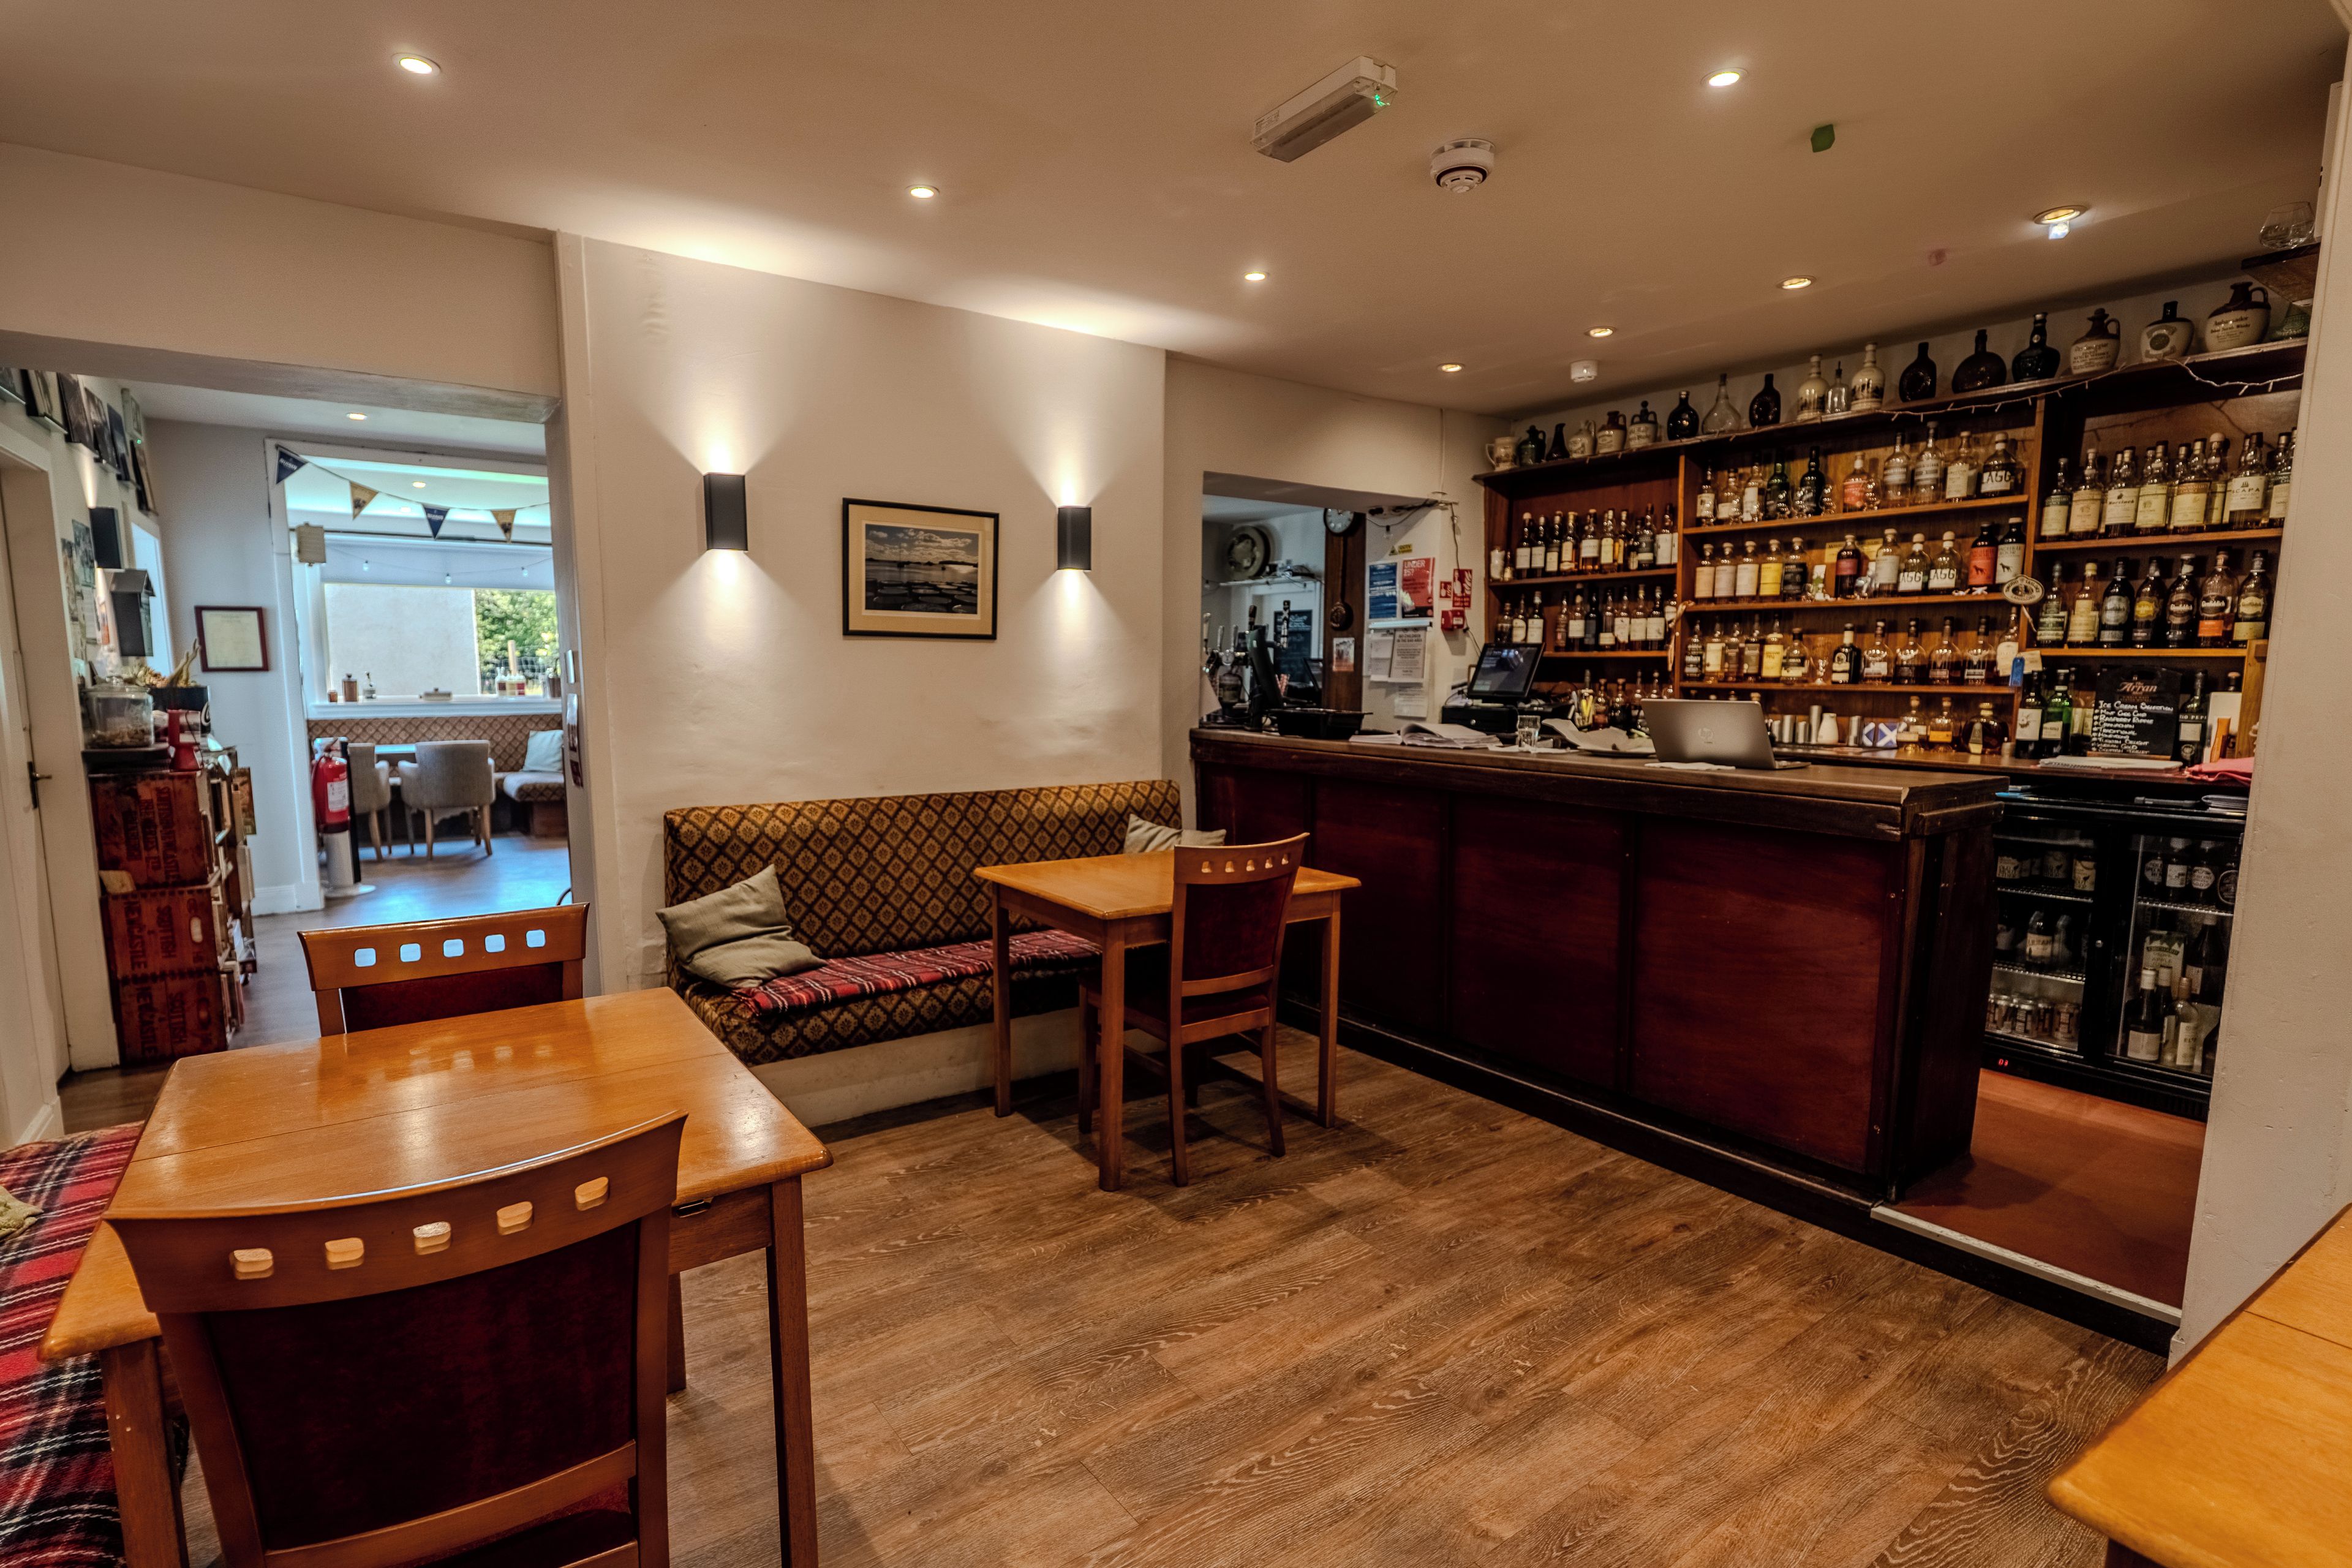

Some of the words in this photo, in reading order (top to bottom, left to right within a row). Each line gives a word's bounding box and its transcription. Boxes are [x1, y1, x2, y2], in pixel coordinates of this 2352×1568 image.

[1404, 559, 1426, 568] UNDER
[2117, 682, 2157, 692] Arran
[124, 900, 148, 971] NEWCASTLE
[157, 905, 176, 959] SCOTTISH
[136, 986, 158, 1057] NEWCASTLE
[168, 992, 187, 1045] SCOTTISH
